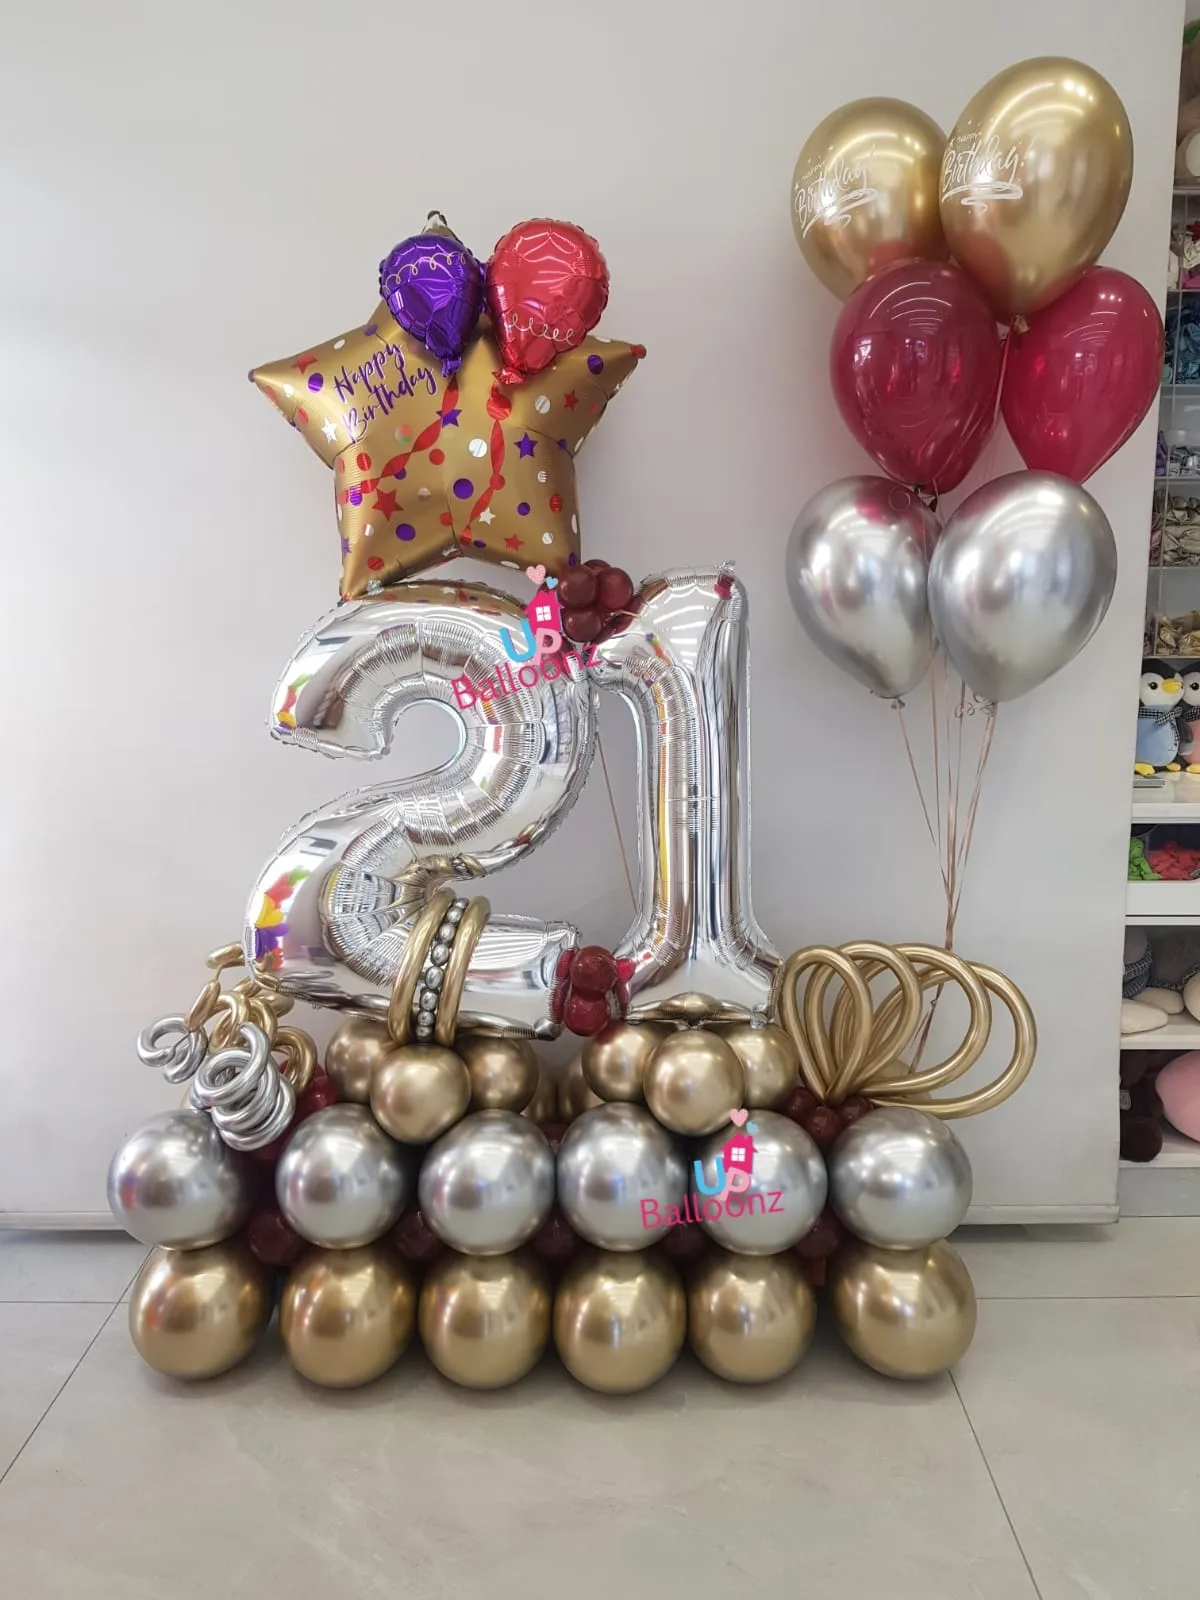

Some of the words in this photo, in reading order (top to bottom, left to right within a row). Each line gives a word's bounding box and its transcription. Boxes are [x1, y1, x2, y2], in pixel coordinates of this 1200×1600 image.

[941, 134, 1019, 193] Birthday
[333, 342, 406, 404] Happy
[342, 367, 438, 445] Birthday
